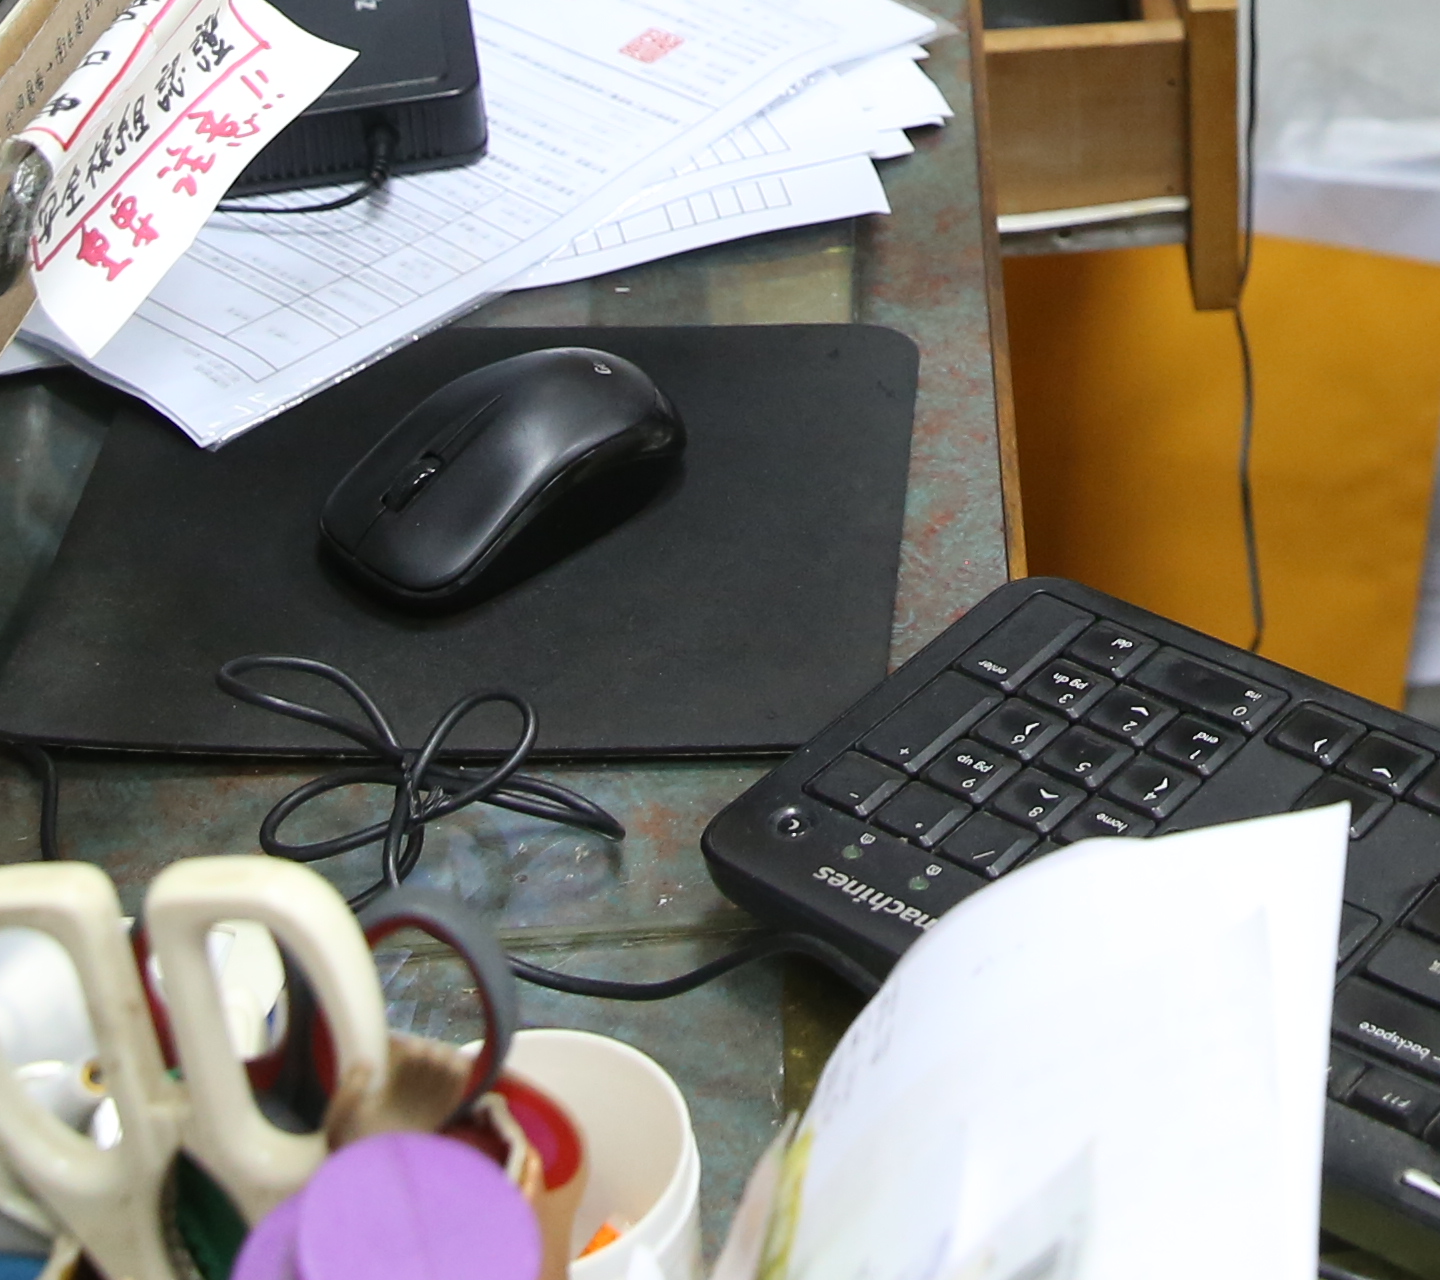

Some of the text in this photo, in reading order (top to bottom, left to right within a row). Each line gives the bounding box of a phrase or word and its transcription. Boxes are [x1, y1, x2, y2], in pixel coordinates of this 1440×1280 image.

[1111, 638, 1133, 649] del
[977, 658, 1010, 678] enter
[1053, 672, 1089, 690] pg dn
[1058, 694, 1075, 710] 3
[1244, 690, 1262, 700] ins
[1232, 705, 1248, 722] 0
[1123, 721, 1139, 736] 2
[1011, 735, 1027, 750] 6
[1192, 731, 1219, 744] end
[957, 754, 994, 773] pg up
[1189, 749, 1203, 763] 1
[1075, 762, 1091, 777] 5
[961, 778, 976, 793] 9
[1143, 787, 1158, 802] 4
[1028, 806, 1044, 821] 8
[1096, 813, 1128, 833] home
[1358, 1020, 1432, 1062] backspace
[1381, 1092, 1412, 1109] F11
